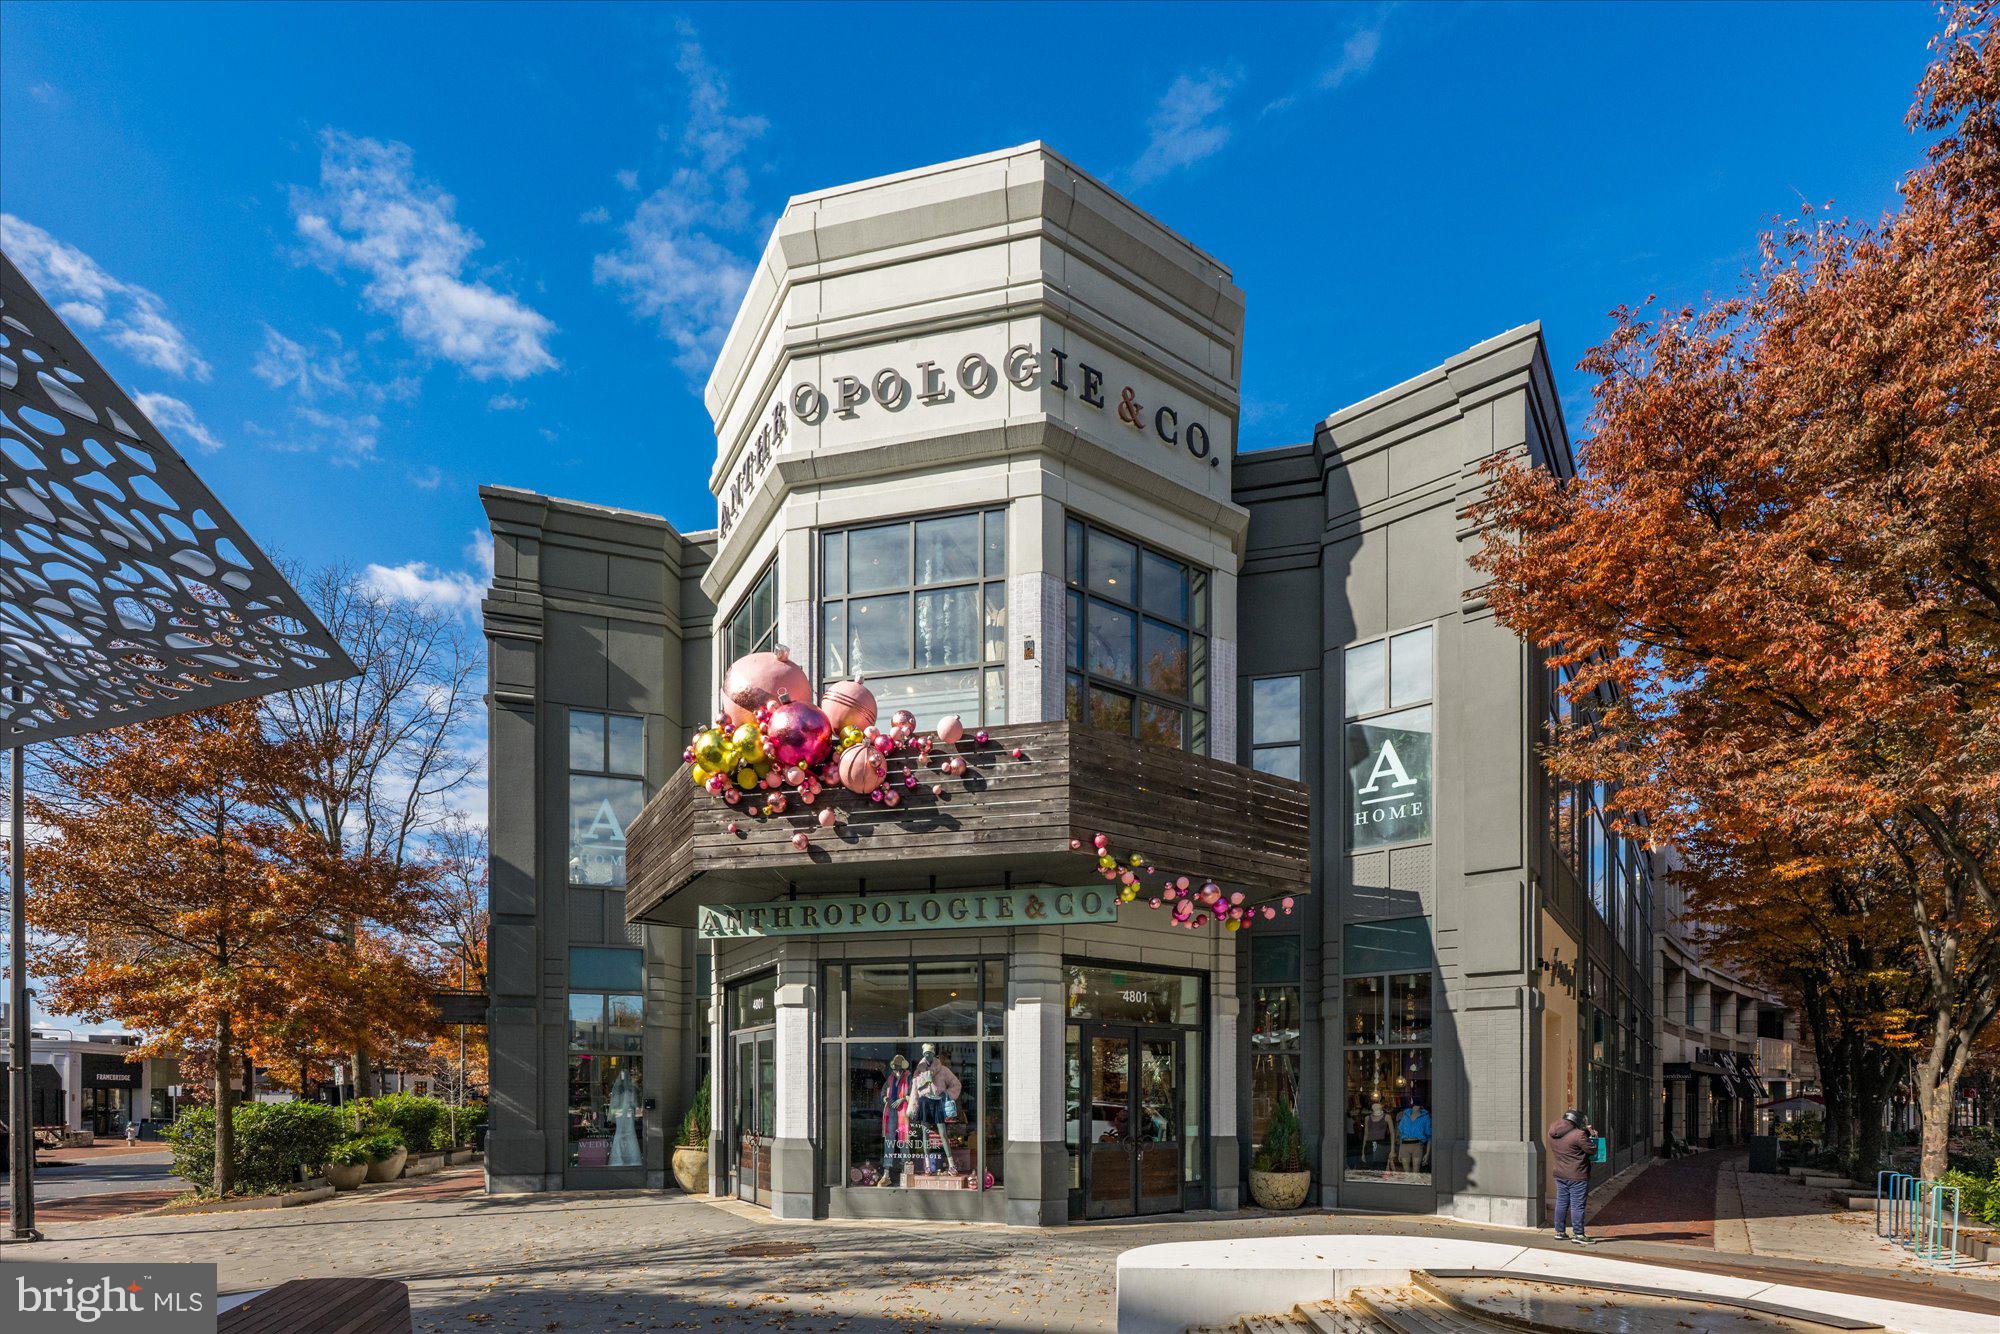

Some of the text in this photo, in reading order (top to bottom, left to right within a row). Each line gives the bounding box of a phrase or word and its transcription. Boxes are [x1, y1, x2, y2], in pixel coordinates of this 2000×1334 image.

[720, 343, 1220, 538] ANTHROPOLOGIE & CO.
[1358, 739, 1418, 794] A
[1354, 801, 1423, 826] HOME
[579, 853, 625, 866] HOM
[700, 890, 1114, 933] ANTHROPOLOGIE & CO.
[1122, 990, 1148, 1003] 4801
[96, 1073, 131, 1081] FRAMEBRIDGE
[885, 1140, 941, 1150] WONDER
